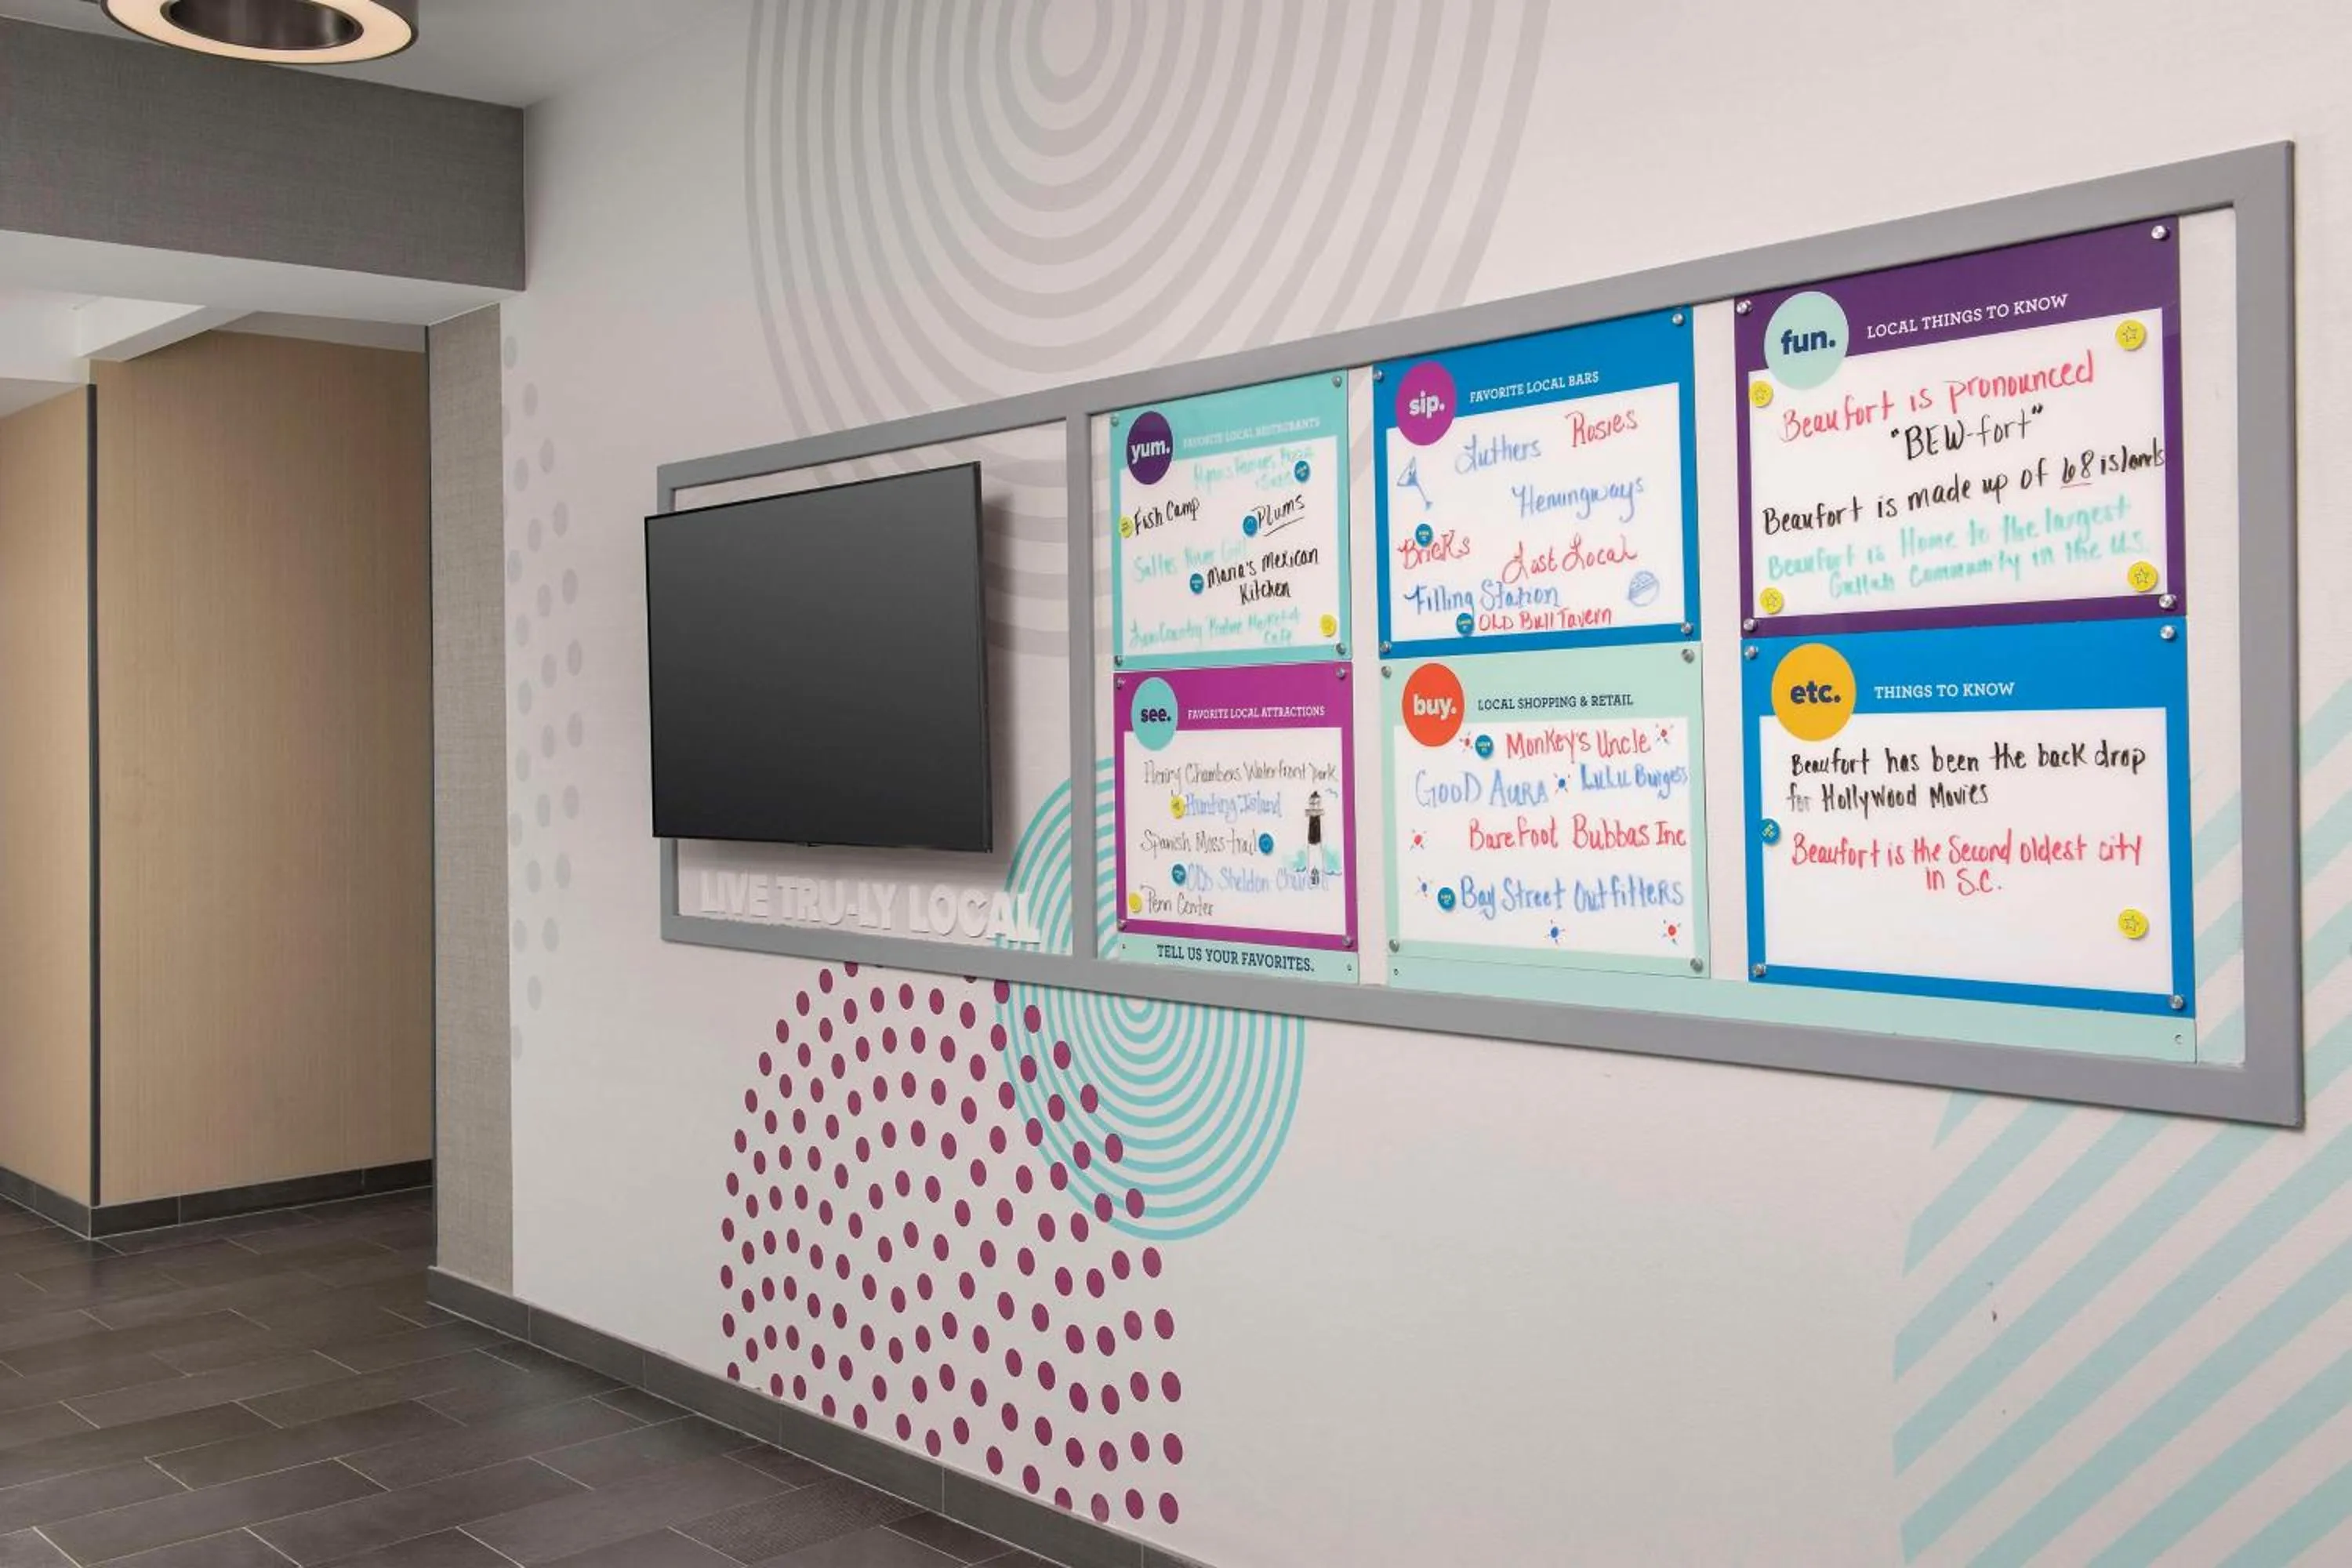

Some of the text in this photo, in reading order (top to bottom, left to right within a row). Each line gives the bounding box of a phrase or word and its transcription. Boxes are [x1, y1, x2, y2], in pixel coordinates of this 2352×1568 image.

[1866, 293, 2069, 339] LOCAL THINGS TO KNOW
[1780, 328, 1836, 355] fun.
[1469, 370, 1600, 404] FAVORITE LOCAL BARS
[1780, 349, 2094, 444] Beaufort is pronounced
[1408, 390, 1446, 419] sip.
[1183, 433, 1223, 448] FAVORITE
[1225, 426, 1254, 443] LOCAL
[1563, 409, 1639, 448] Rosies
[1130, 441, 1171, 464] yum.
[1252, 493, 1306, 528] Plums
[1763, 495, 1864, 536] Beaufort
[1877, 491, 1898, 519] is
[1907, 476, 1971, 512] made
[1982, 473, 2009, 504] up
[2020, 458, 2049, 490] of
[1133, 496, 1201, 537] Fish Camp
[1562, 532, 1639, 573] Local
[1768, 493, 2132, 581] Beaufort is Home to the largest
[2031, 545, 2056, 568] in
[2065, 539, 2103, 564] the
[1206, 561, 1258, 589] Maria's
[1239, 579, 1292, 606] Kitchen
[1403, 578, 1562, 618] Filling Station
[1519, 611, 1555, 632] Bull
[1557, 606, 1613, 630] Tavern
[1478, 693, 1634, 712] LOCAL SHOPPING & RETAIL
[1790, 680, 1842, 705] etc.
[1874, 681, 2015, 700] THINGS TO KNOW
[1140, 706, 1172, 724] see.
[1188, 704, 1326, 720] FAVORITE LOCAL ATTRACTIONS
[1413, 695, 1457, 720] buy.
[1596, 728, 1653, 759] Uncle
[1791, 746, 1871, 777] Beaufort
[1883, 747, 1920, 774] has
[1931, 745, 1980, 774] been
[1989, 741, 2027, 771] the
[2093, 739, 2147, 775] drop
[1184, 760, 1243, 786] Chambers
[1784, 782, 1990, 820] for Hollywood Movies
[1140, 828, 1192, 859] Spanish
[1571, 812, 1651, 851] Bubbas
[1654, 818, 1688, 848] Inc
[1791, 827, 2143, 869] Beaufort is the Second oldest city
[1218, 866, 1270, 895] Sheldon
[1956, 867, 2003, 896] S.C.
[700, 870, 1040, 944] LIVE TRU-LY LOCAL
[1140, 883, 1215, 917] Penn Center
[1459, 874, 1497, 921] Bay
[1500, 876, 1567, 913] Street
[1156, 944, 1316, 973] TELL US YOUR FAVORITES.
